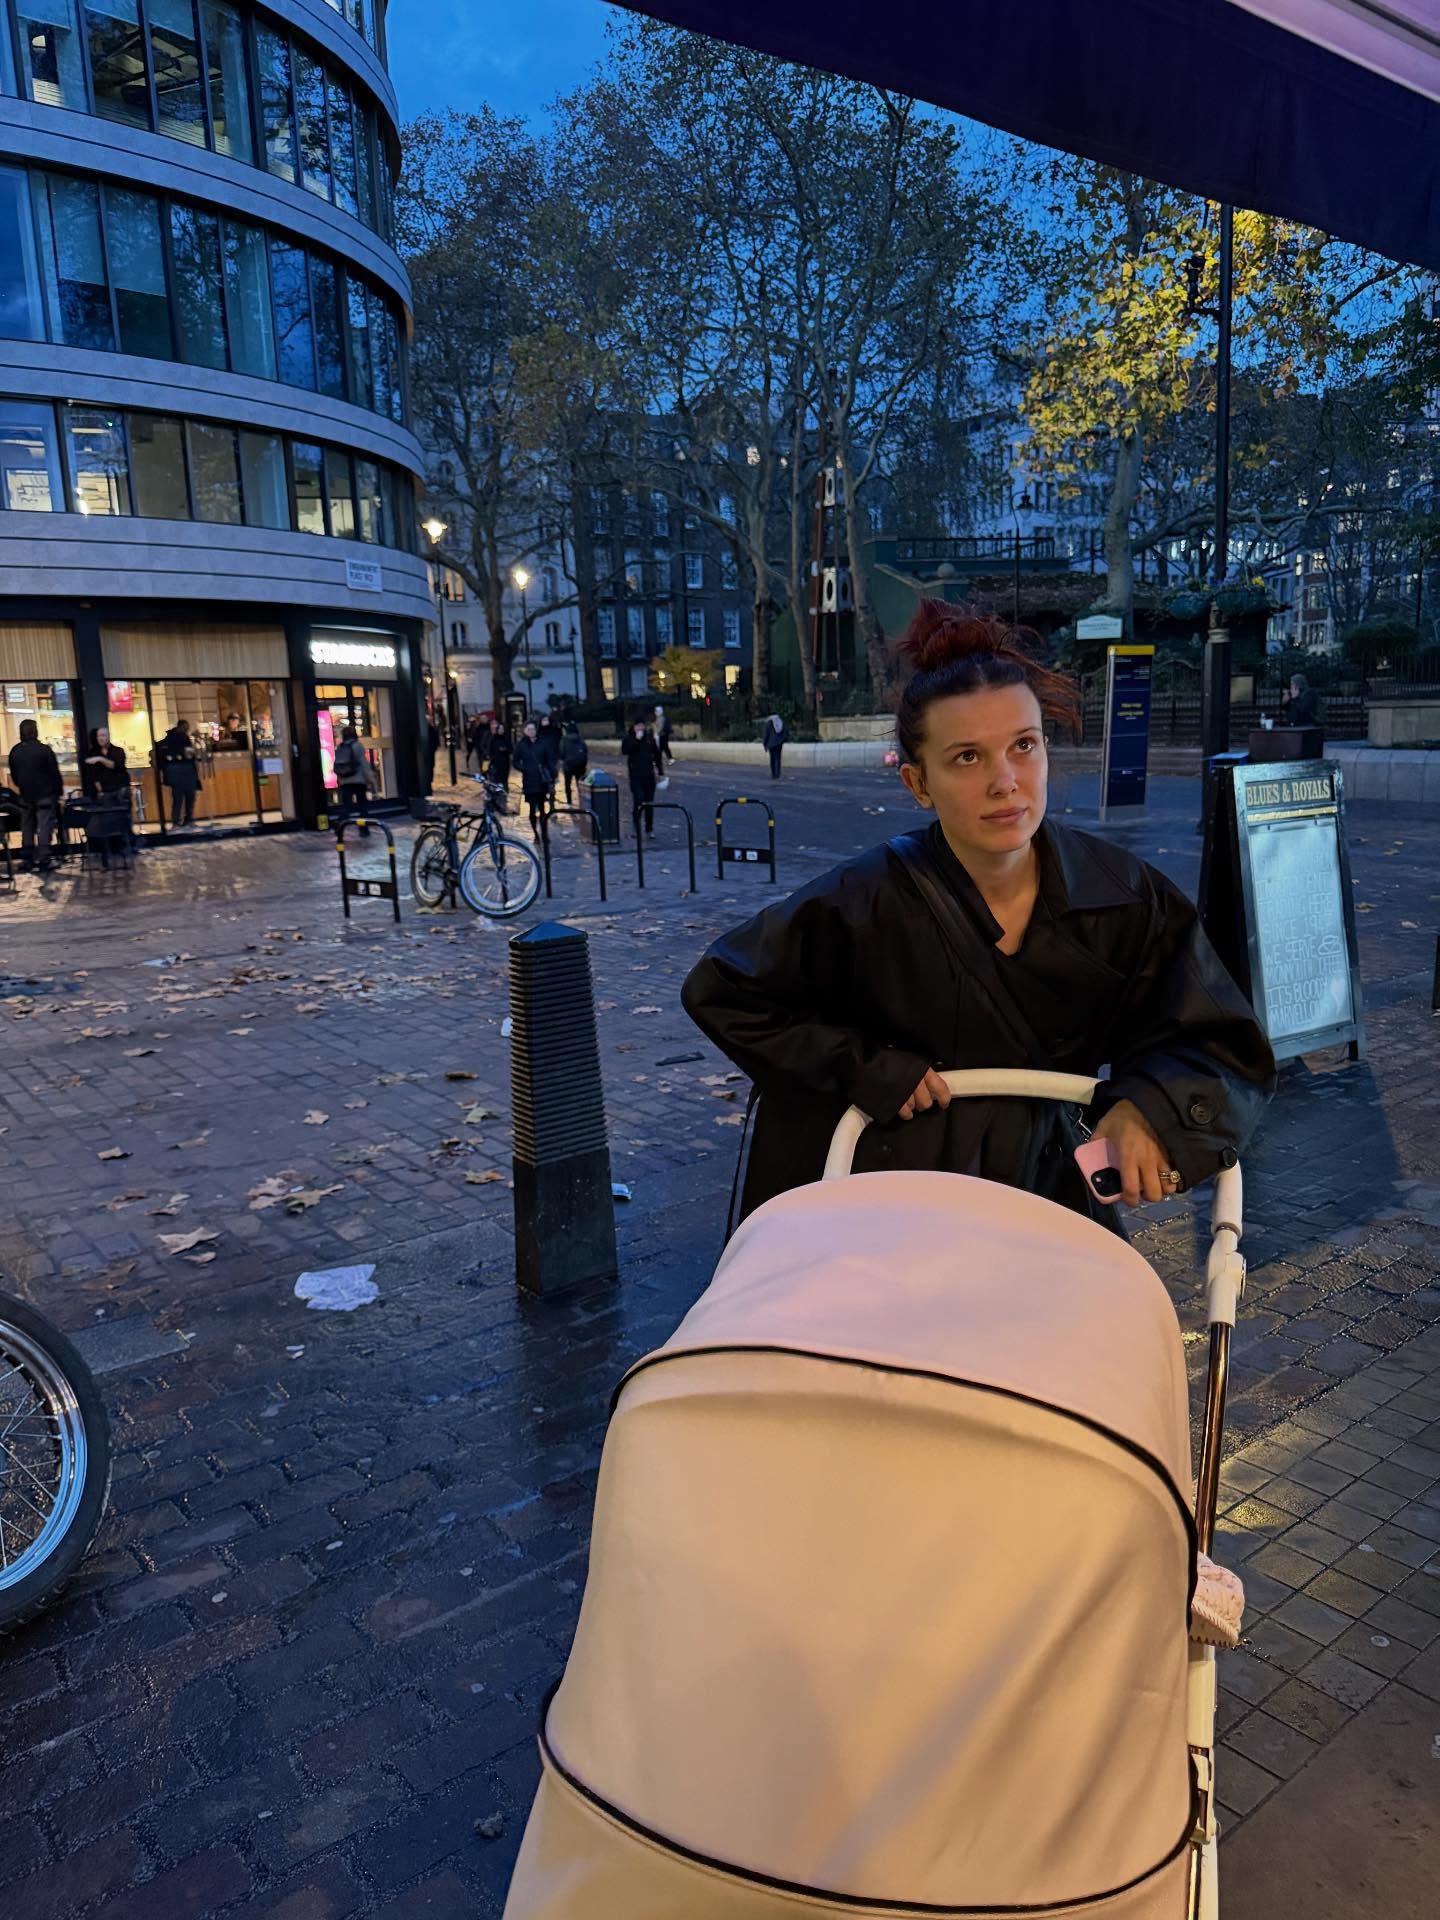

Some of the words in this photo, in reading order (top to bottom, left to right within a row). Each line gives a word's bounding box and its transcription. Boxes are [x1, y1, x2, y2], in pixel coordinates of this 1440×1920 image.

[1246, 783, 1280, 806] BLUES
[1282, 782, 1290, 802] &
[1291, 779, 1331, 801] ROYALS
